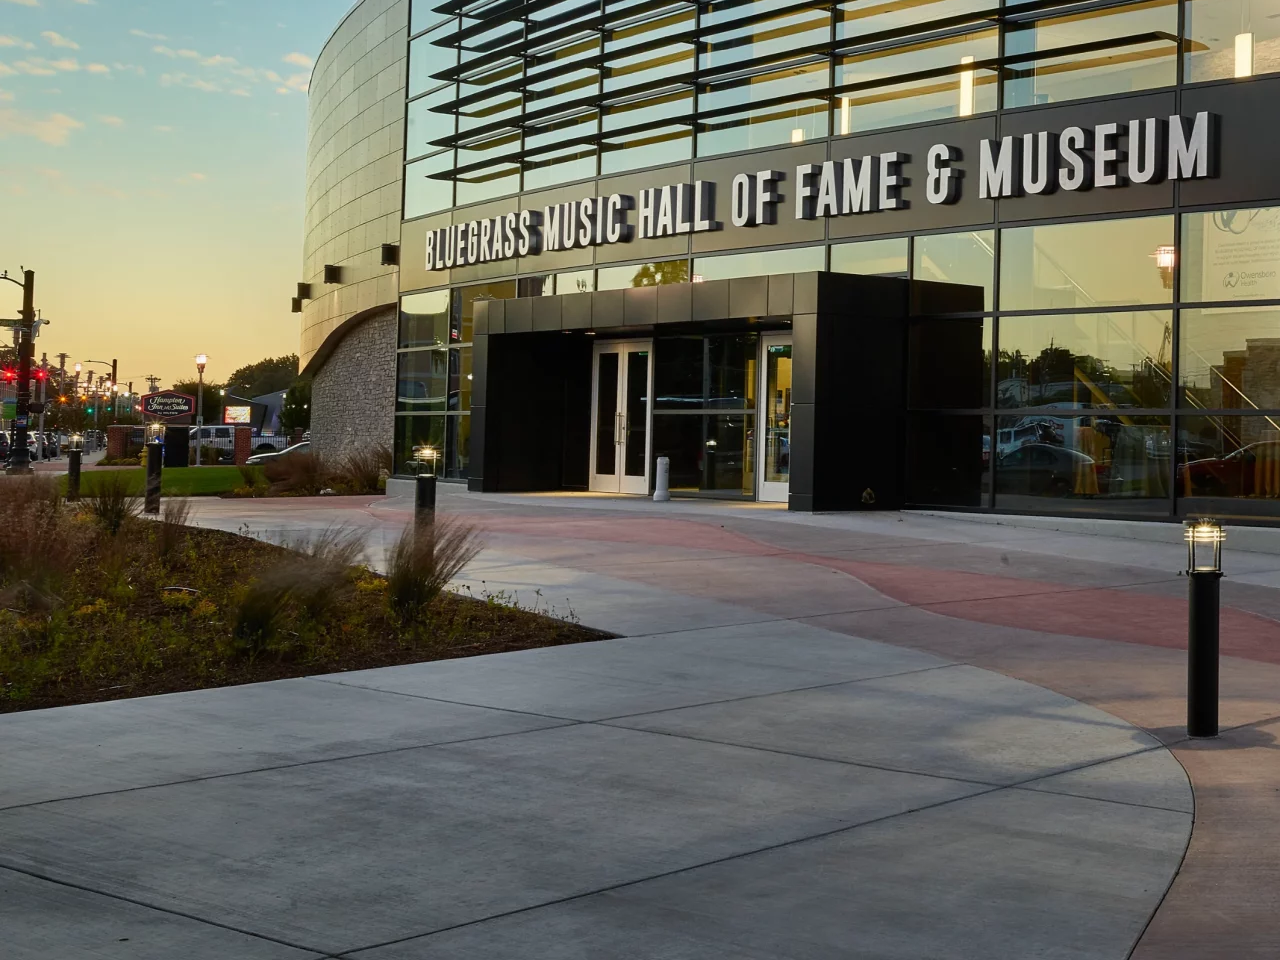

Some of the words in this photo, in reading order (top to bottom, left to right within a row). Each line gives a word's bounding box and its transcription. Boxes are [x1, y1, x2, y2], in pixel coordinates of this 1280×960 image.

[425, 209, 535, 271] BLUEGRASS
[542, 193, 624, 252] MUSIC
[638, 180, 713, 240] HALL
[731, 169, 775, 228] OF
[795, 151, 900, 220] FAME
[925, 142, 955, 205] &
[979, 111, 1210, 200] MUSEUM
[1240, 270, 1276, 279] Owensboro
[149, 396, 186, 405] Hampton
